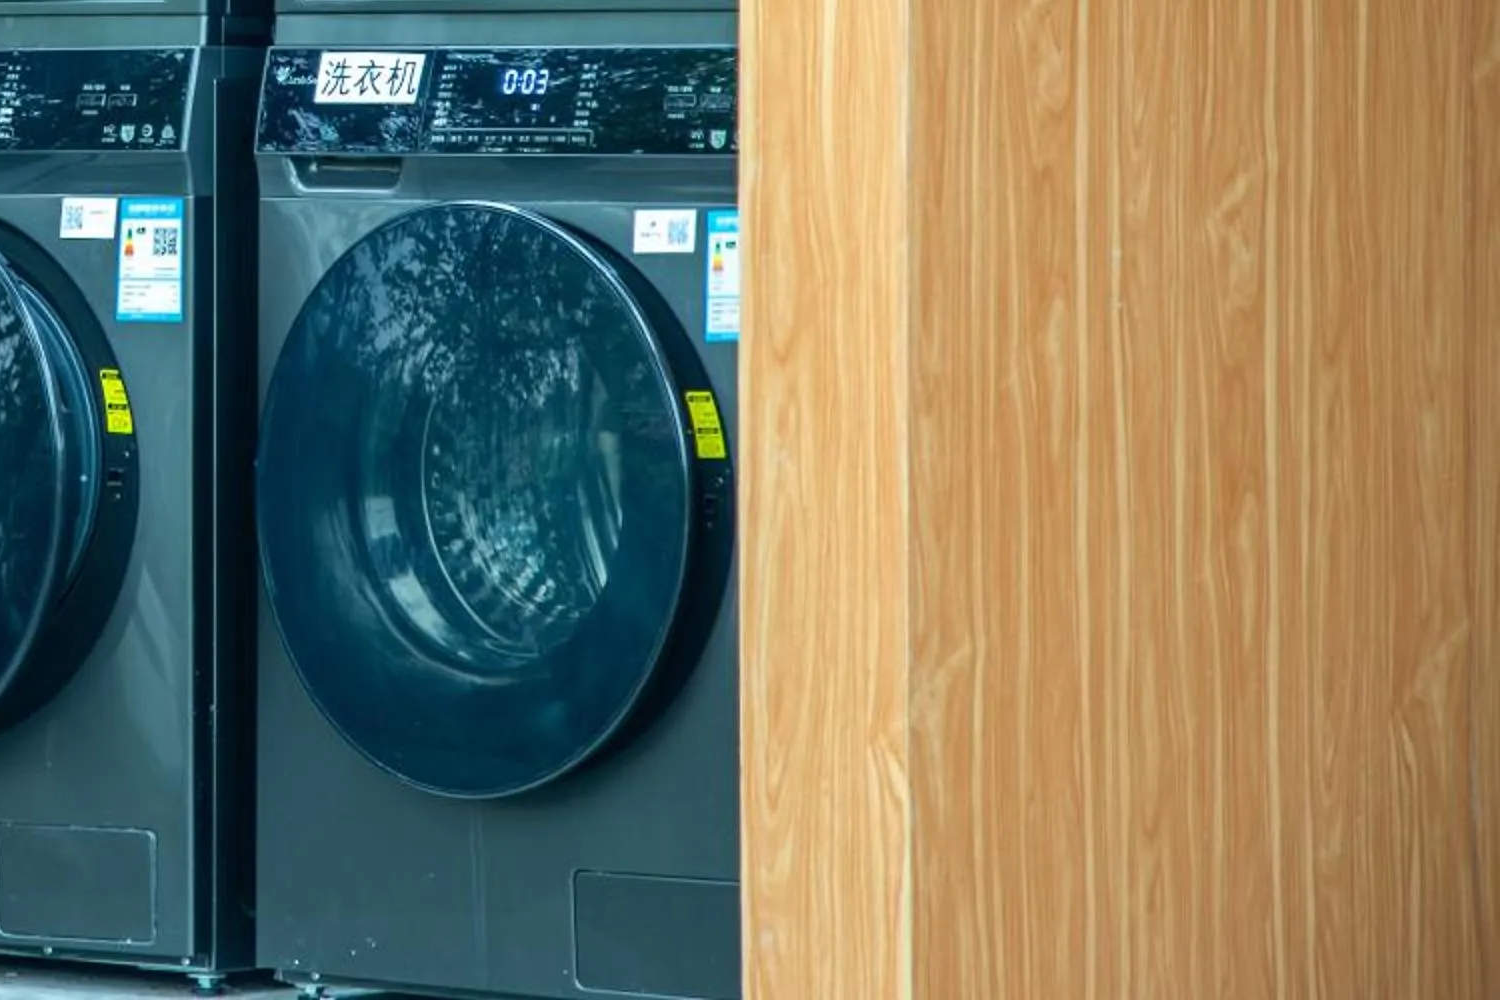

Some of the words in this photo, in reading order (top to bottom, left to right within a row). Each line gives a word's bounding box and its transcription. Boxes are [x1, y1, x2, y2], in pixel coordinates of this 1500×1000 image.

[321, 57, 416, 96] 洗衣机
[503, 69, 549, 95] 0:03
